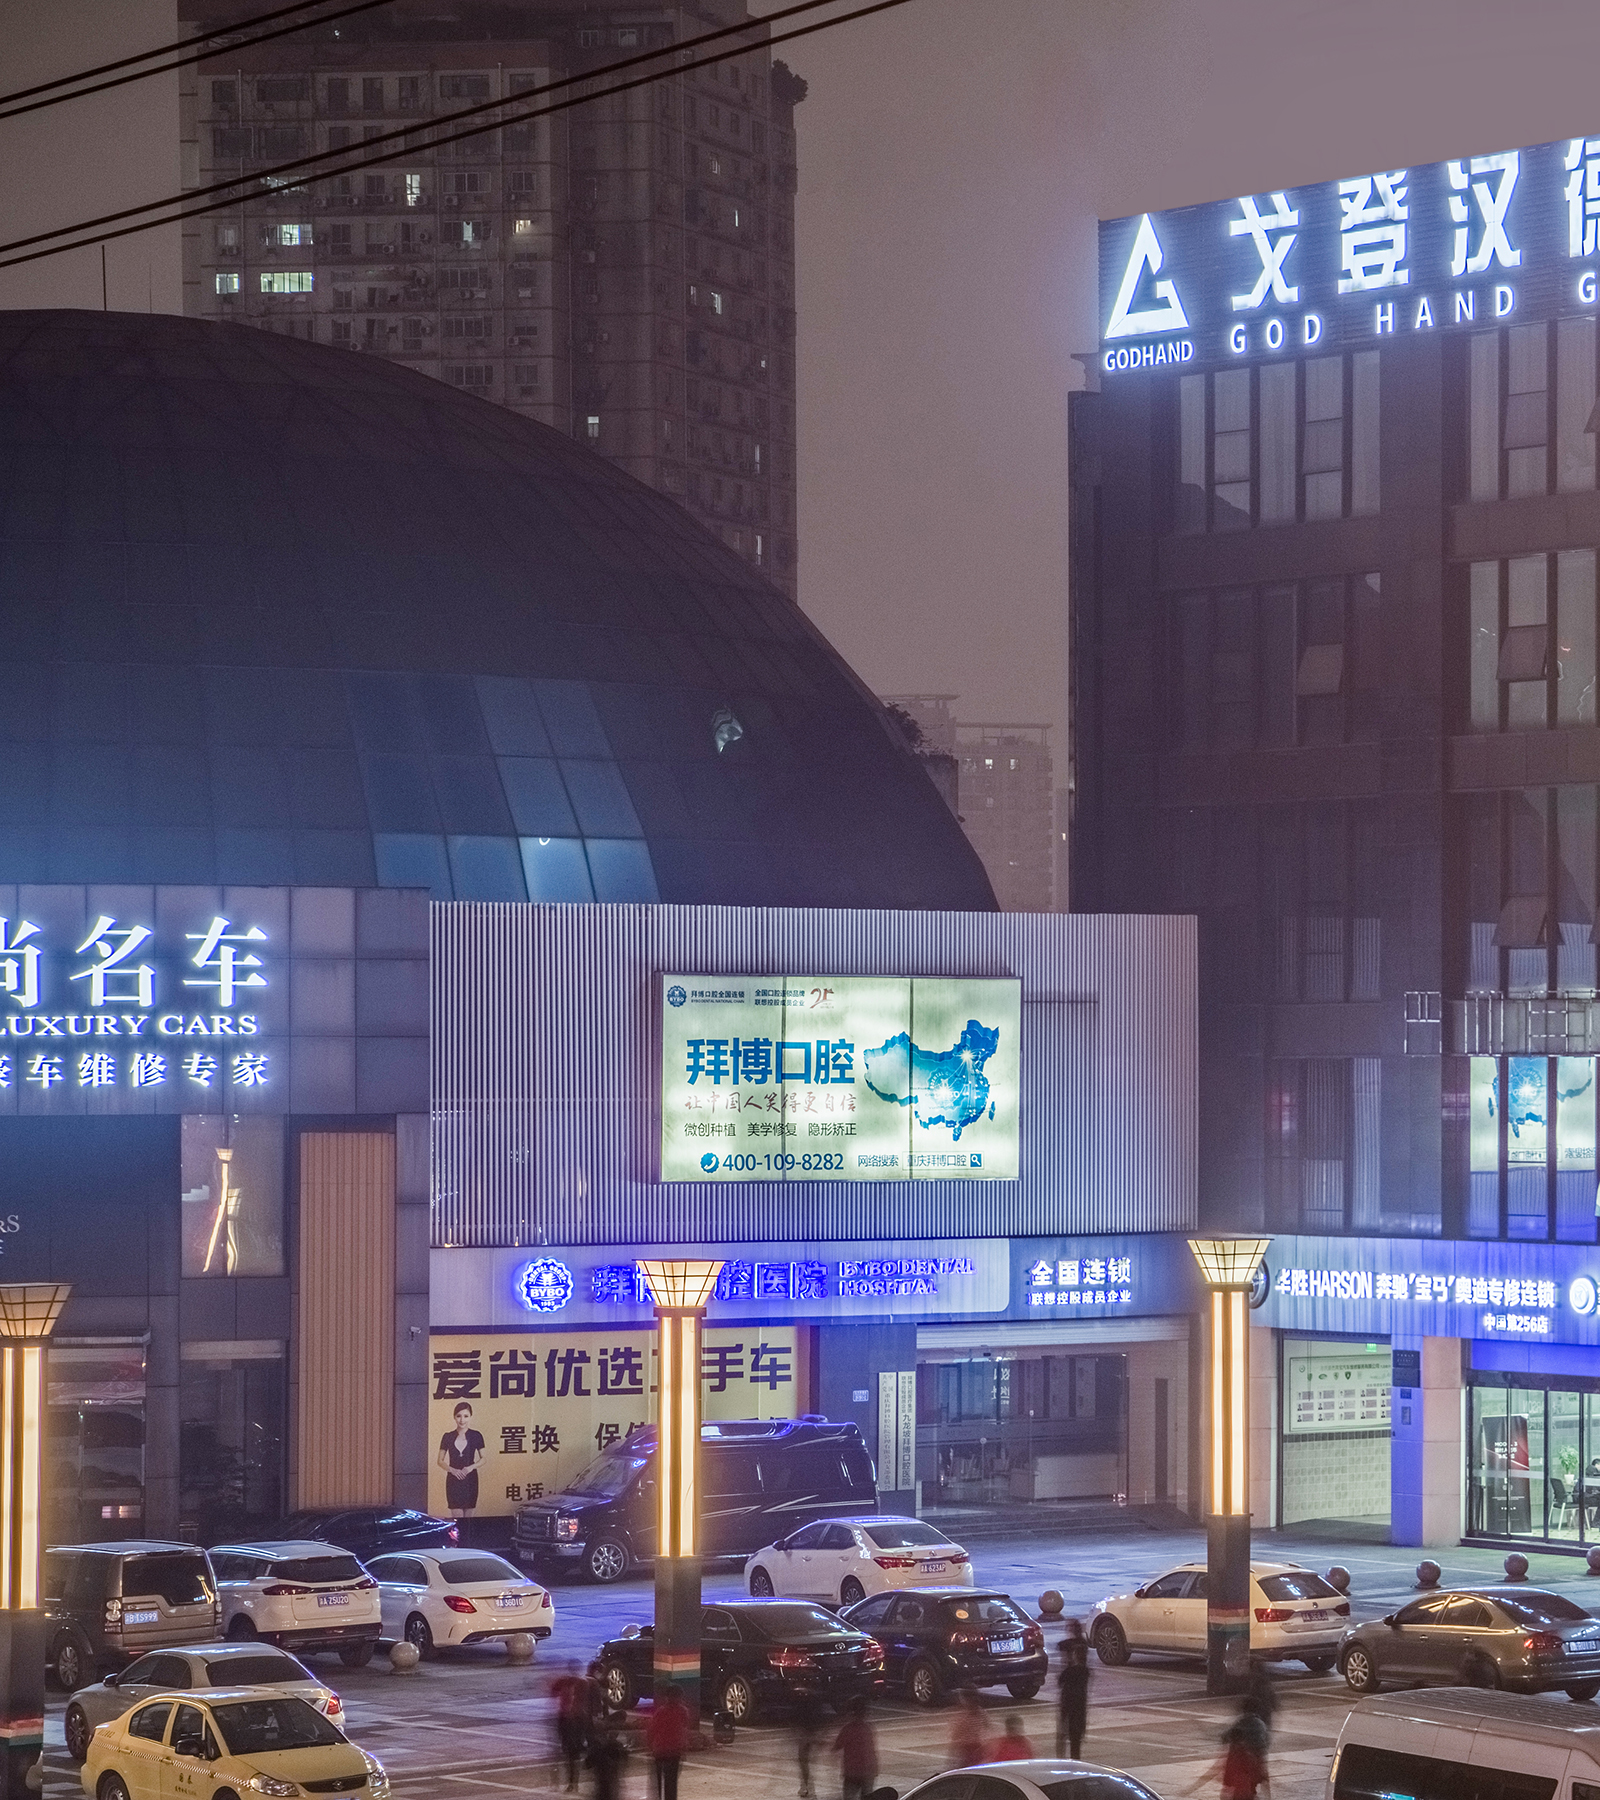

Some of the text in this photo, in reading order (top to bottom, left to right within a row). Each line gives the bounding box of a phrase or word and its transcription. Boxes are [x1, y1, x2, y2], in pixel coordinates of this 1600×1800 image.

[1228, 313, 1324, 355] GOD
[1375, 285, 1516, 335] HAND
[1103, 341, 1195, 372] GODHAND
[0, 1015, 259, 1036] UXURY CARS
[686, 1038, 856, 1086] 拜博口腔
[684, 1091, 857, 1114] 让中国人笑得更自信
[684, 1121, 857, 1138] 微创种植 美学修复 隐形矫正
[722, 1152, 845, 1172] 400-109-8282
[857, 1154, 899, 1168] 网络搜索
[839, 1258, 977, 1277] BYBO DENTAL
[1030, 1257, 1132, 1286] 全国连锁
[592, 1259, 828, 1303] 拜腔医院
[839, 1278, 939, 1296] HOSPITAL
[530, 1287, 565, 1297] BYBO
[1030, 1289, 1132, 1306] 联想控股成员企业
[1483, 1312, 1549, 1334] 中国第256店
[500, 1425, 560, 1454] 置换
